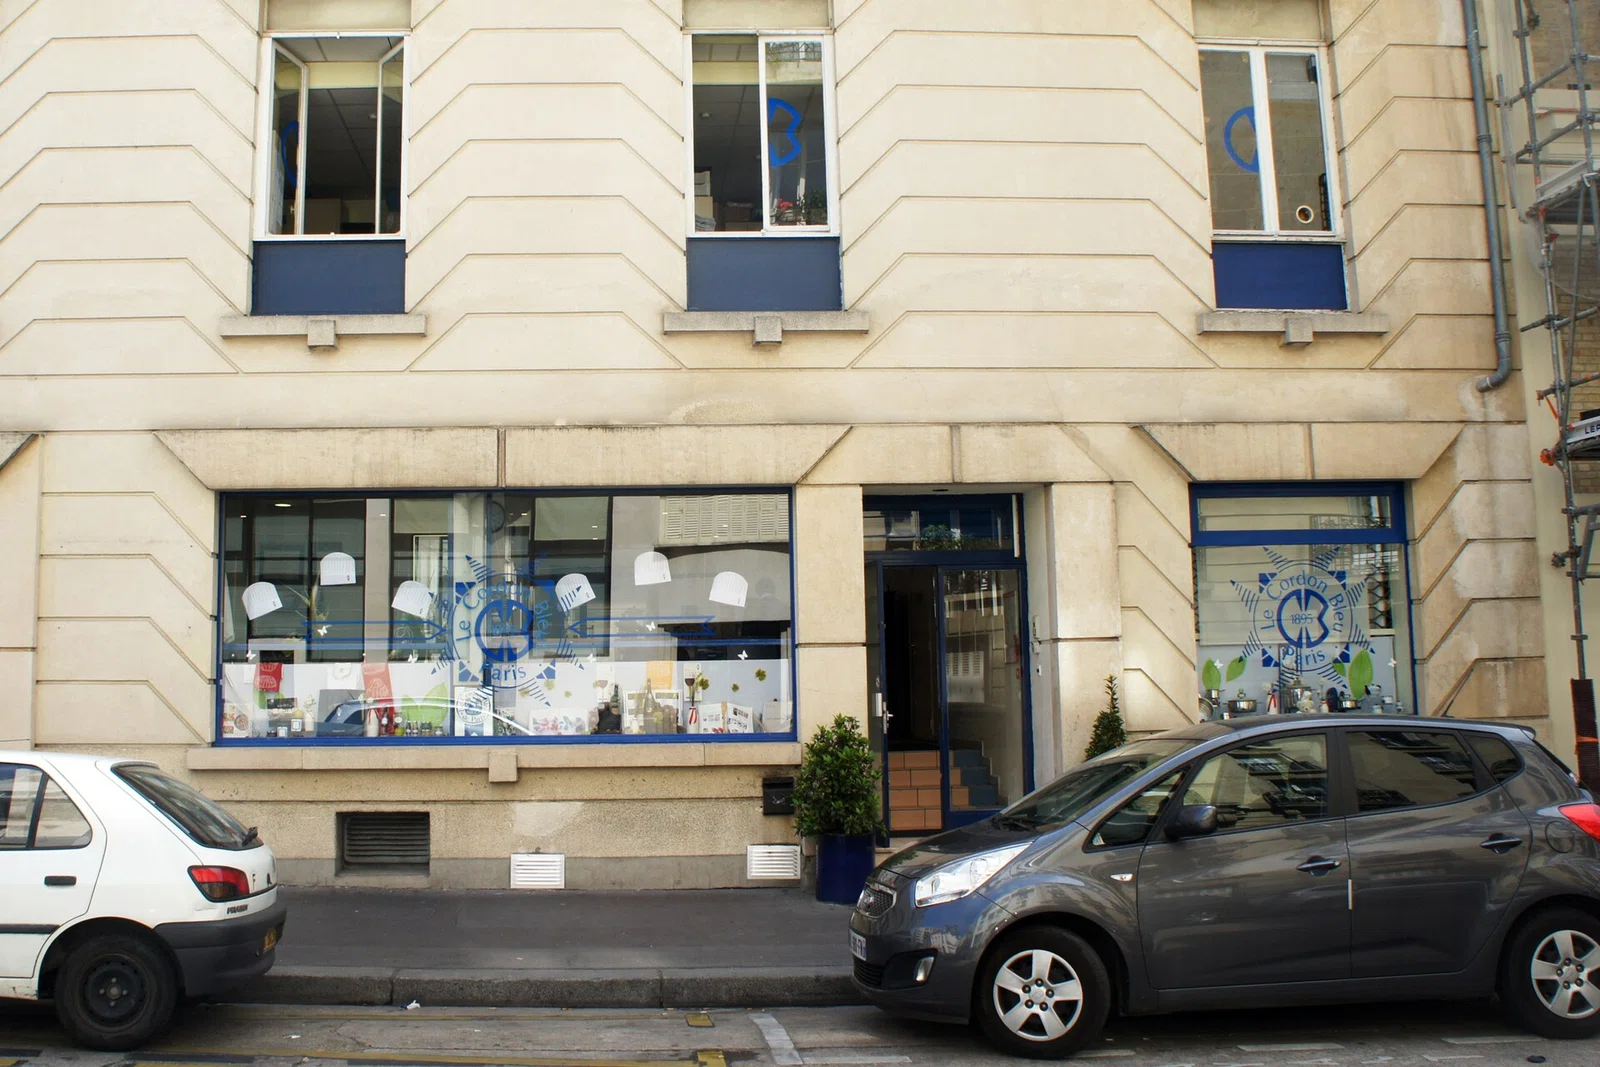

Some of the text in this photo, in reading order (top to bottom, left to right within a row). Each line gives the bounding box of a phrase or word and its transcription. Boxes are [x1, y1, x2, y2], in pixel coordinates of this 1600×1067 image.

[1260, 570, 1347, 633] Le Cordon Bleu
[1289, 613, 1314, 626] 1895
[456, 620, 472, 642] Le
[1281, 645, 1326, 666] Paris
[479, 658, 527, 681] Paris
